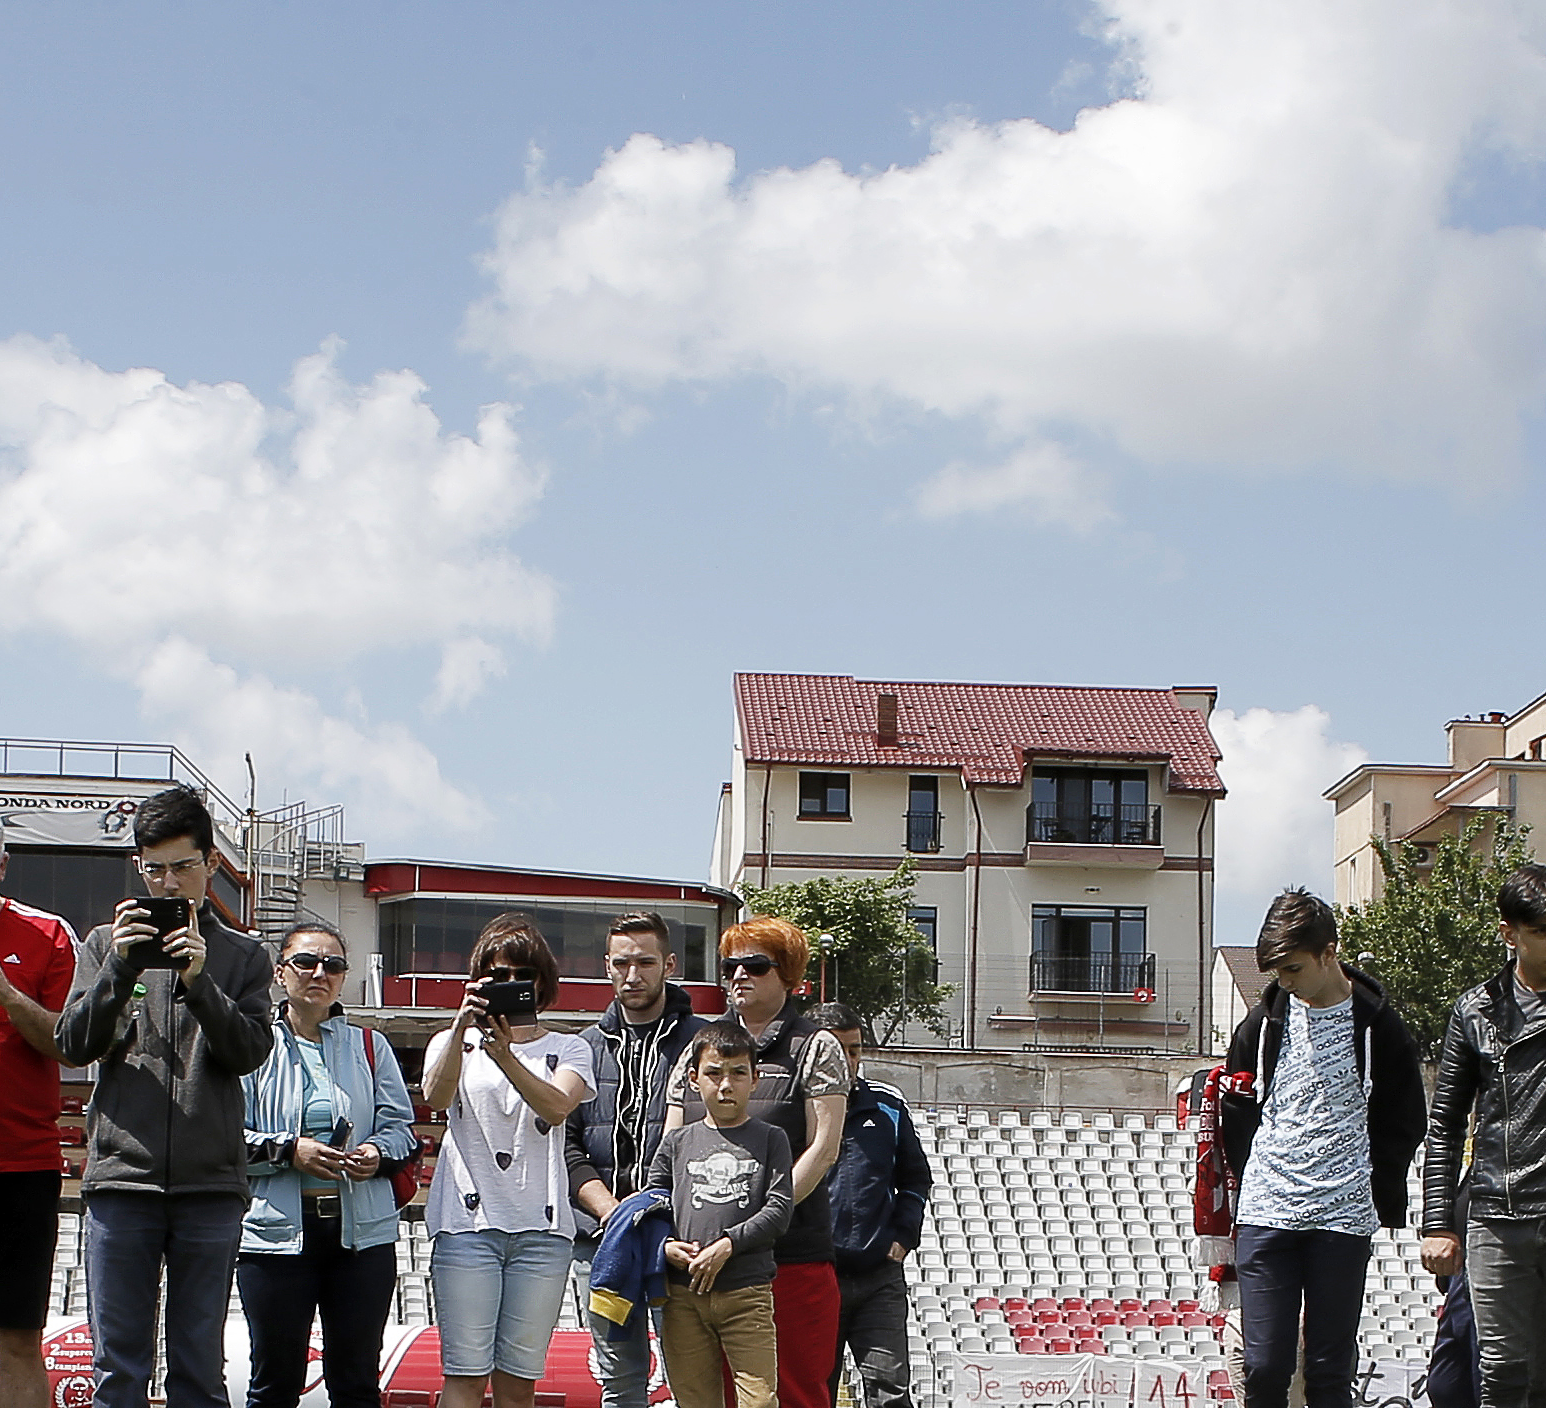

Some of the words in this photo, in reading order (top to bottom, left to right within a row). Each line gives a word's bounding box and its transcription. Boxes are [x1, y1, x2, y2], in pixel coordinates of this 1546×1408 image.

[54, 798, 111, 811] NORD
[1289, 1077, 1332, 1102] adidas
[1316, 1131, 1357, 1155] adidas
[64, 1331, 85, 1344] 13
[50, 1343, 61, 1356] 2
[55, 1363, 94, 1373] campion
[963, 1363, 1003, 1401] Te
[1019, 1379, 1072, 1399] vom
